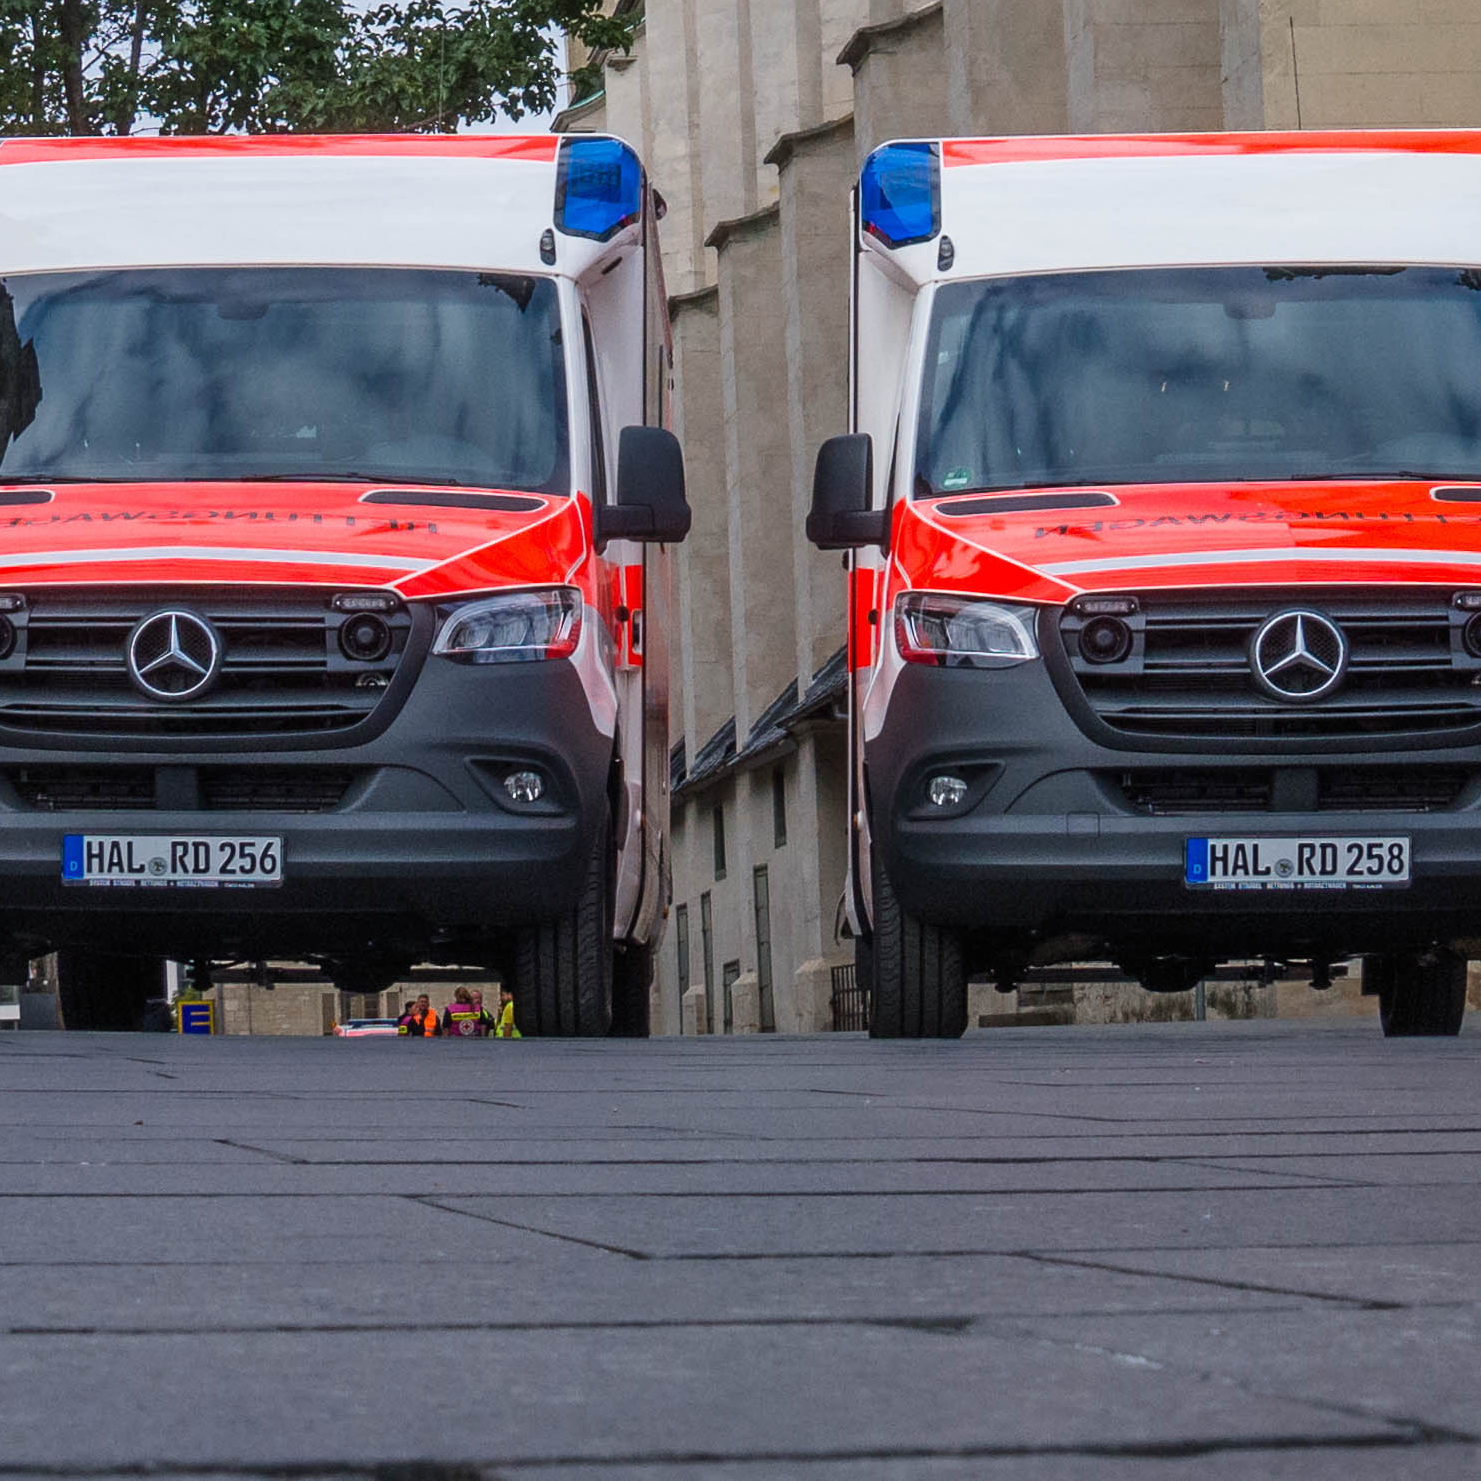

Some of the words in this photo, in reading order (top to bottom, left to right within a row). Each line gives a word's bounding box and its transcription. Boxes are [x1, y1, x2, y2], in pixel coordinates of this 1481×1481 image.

[70, 861, 78, 871] D
[86, 841, 146, 874] HAL
[171, 841, 211, 874] RD
[219, 842, 277, 875] 256
[1193, 864, 1202, 874] D
[1210, 843, 1271, 876] HAL
[1297, 843, 1338, 876] RD
[1346, 843, 1405, 876] 258
